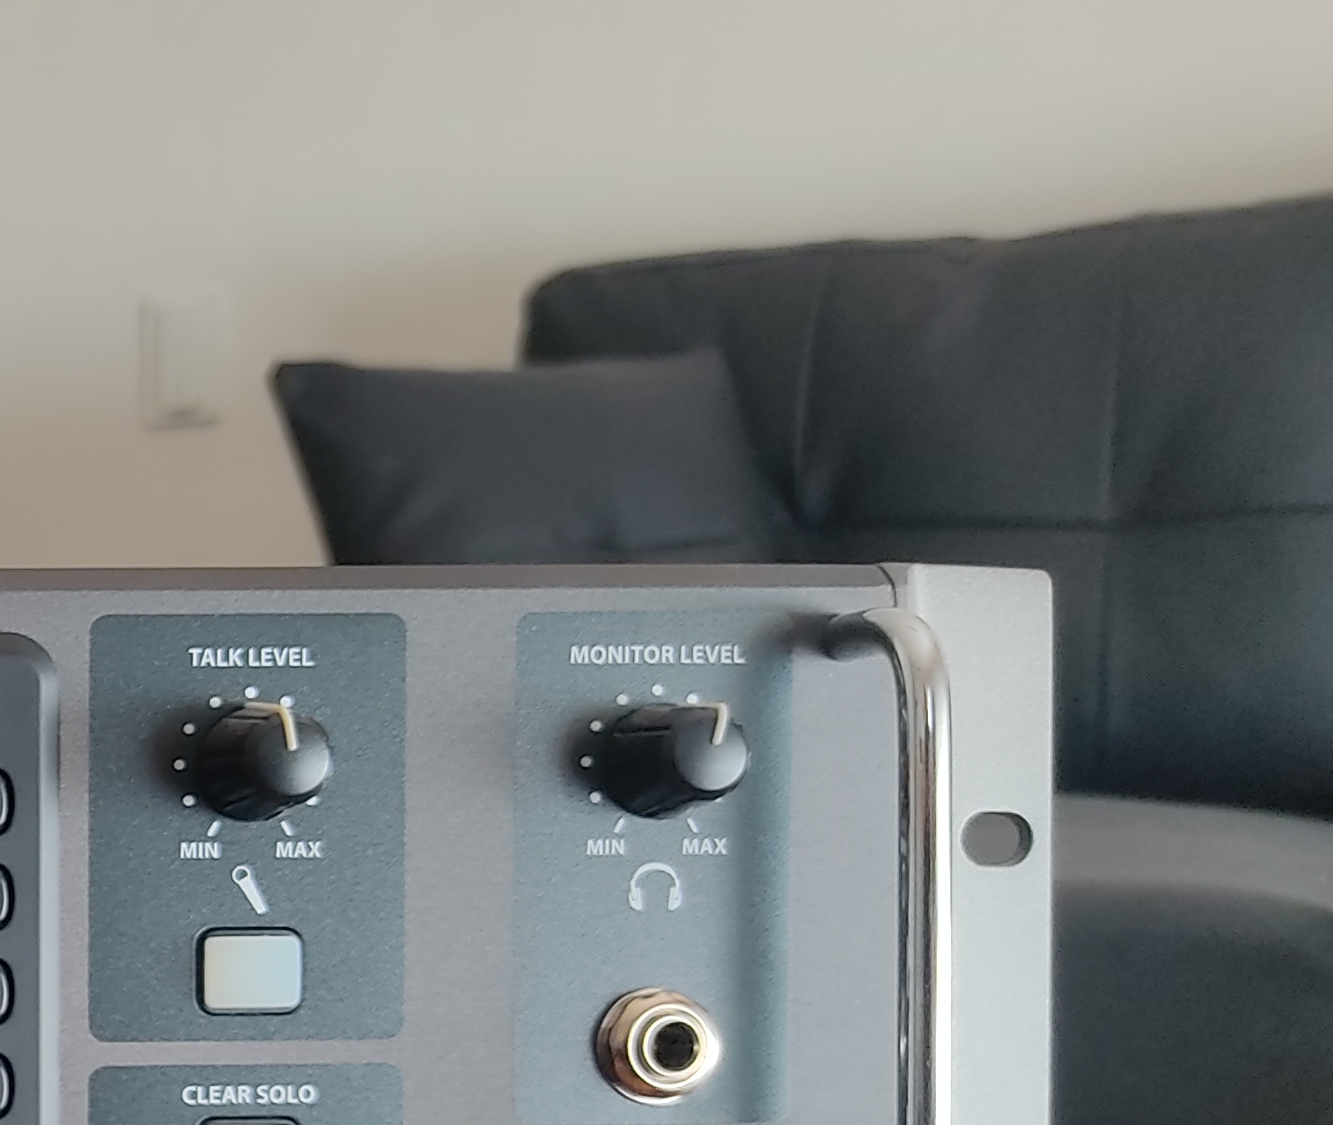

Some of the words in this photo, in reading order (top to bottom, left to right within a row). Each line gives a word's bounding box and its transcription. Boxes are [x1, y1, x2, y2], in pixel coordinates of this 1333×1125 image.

[188, 648, 245, 667] TALK
[248, 647, 316, 667] LEVEL
[570, 646, 674, 664] MONITOR
[680, 645, 747, 664] LEVEL
[180, 842, 221, 859] MIN
[275, 841, 322, 858] MAX
[586, 839, 625, 855] MIN
[682, 838, 728, 855] MAX
[182, 1085, 251, 1106] CLEAR
[256, 1084, 319, 1105] SOLO
